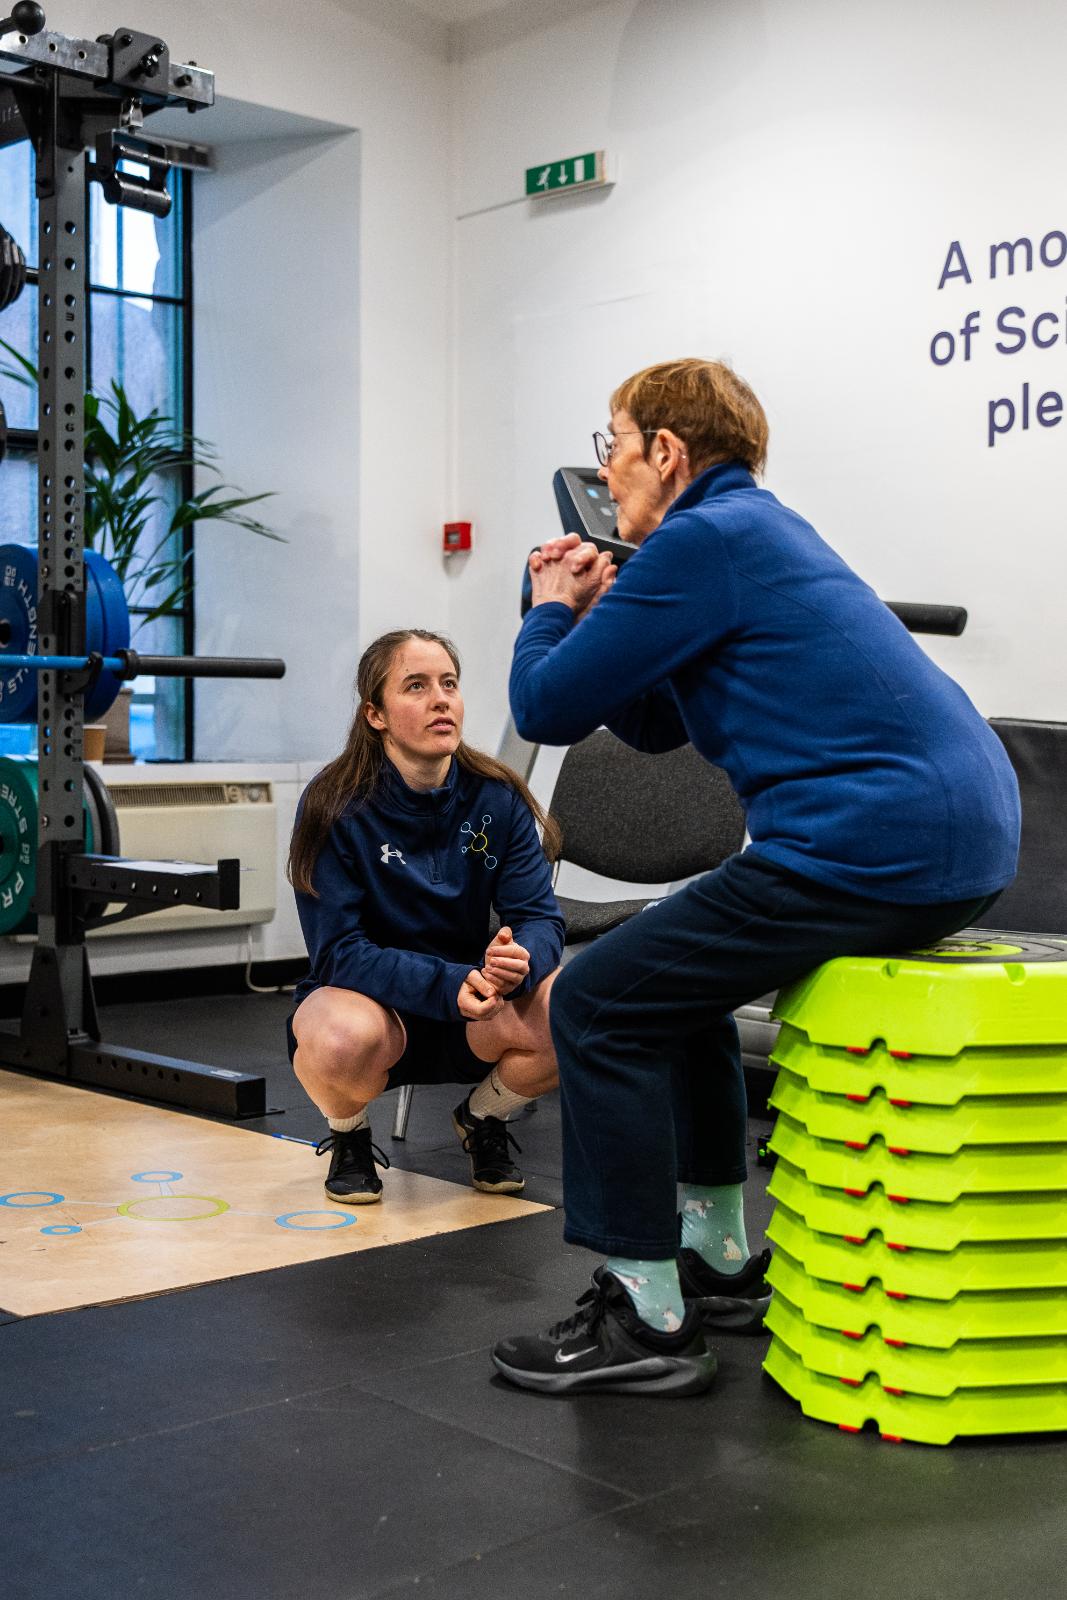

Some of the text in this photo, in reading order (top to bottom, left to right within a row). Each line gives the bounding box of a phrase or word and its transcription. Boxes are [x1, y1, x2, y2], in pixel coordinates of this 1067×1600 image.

[938, 230, 1067, 290] A mo
[930, 298, 1067, 366] of Sc
[988, 382, 1064, 448] ple
[7, 578, 37, 695] STENGTH
